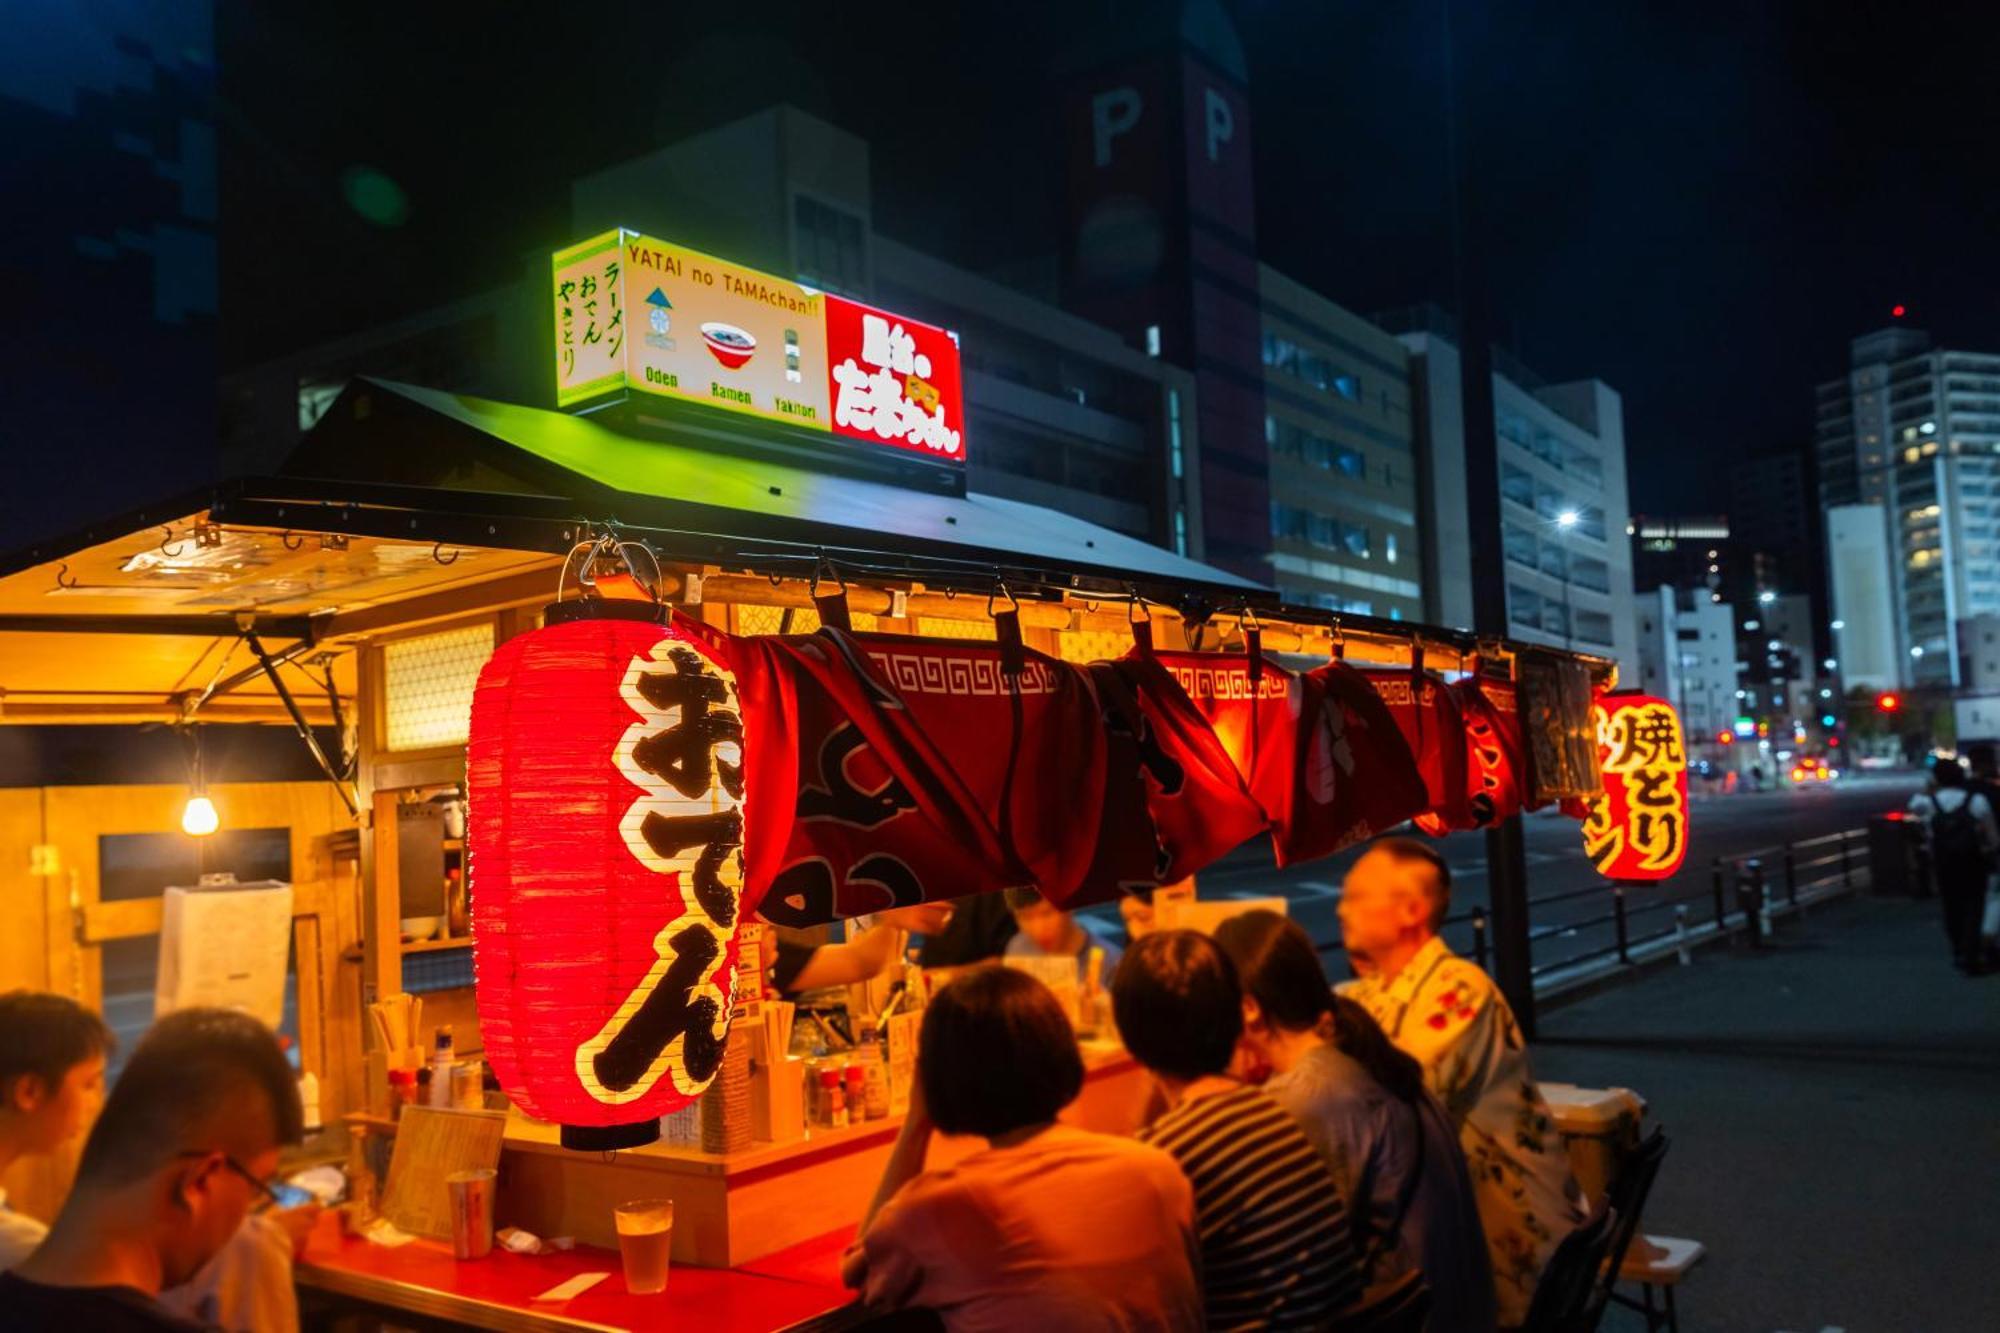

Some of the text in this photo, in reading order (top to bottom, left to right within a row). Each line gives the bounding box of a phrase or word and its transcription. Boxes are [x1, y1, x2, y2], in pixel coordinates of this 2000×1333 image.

[1092, 87, 1142, 166] P
[1204, 87, 1235, 161] P
[629, 245, 682, 276] YATAI
[692, 269, 713, 286] no
[604, 262, 624, 358] ラーメン
[645, 367, 678, 387] Oden
[711, 382, 752, 405] Ramen
[1612, 707, 1681, 867] 焼とり
